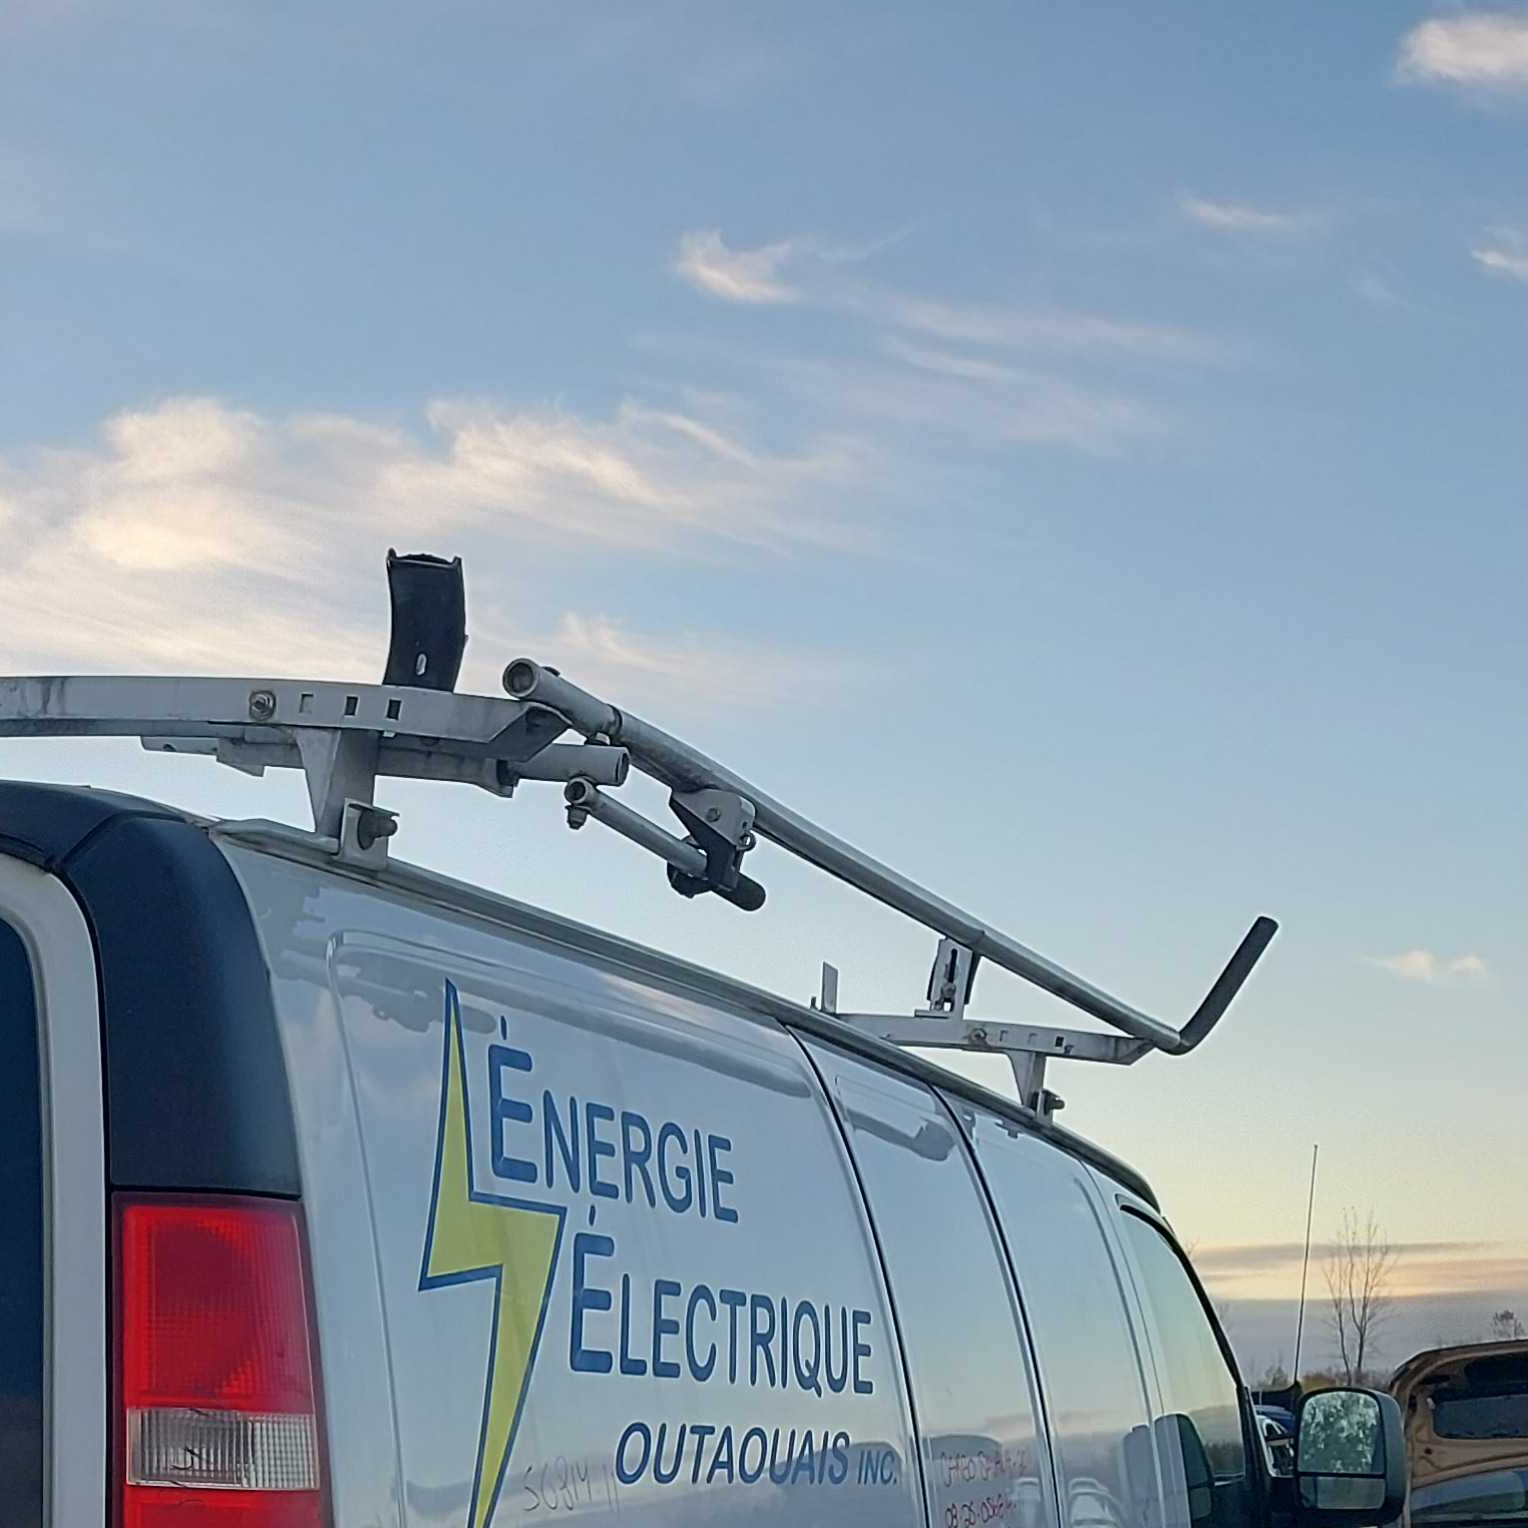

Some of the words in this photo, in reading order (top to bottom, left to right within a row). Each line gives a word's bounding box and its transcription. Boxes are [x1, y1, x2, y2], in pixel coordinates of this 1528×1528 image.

[487, 1014, 739, 1224] ÉNERGIE
[570, 1204, 875, 1398] ÉLECTRIQUE
[615, 1421, 851, 1485] OUTAOUAIS
[857, 1450, 898, 1485] INC.
